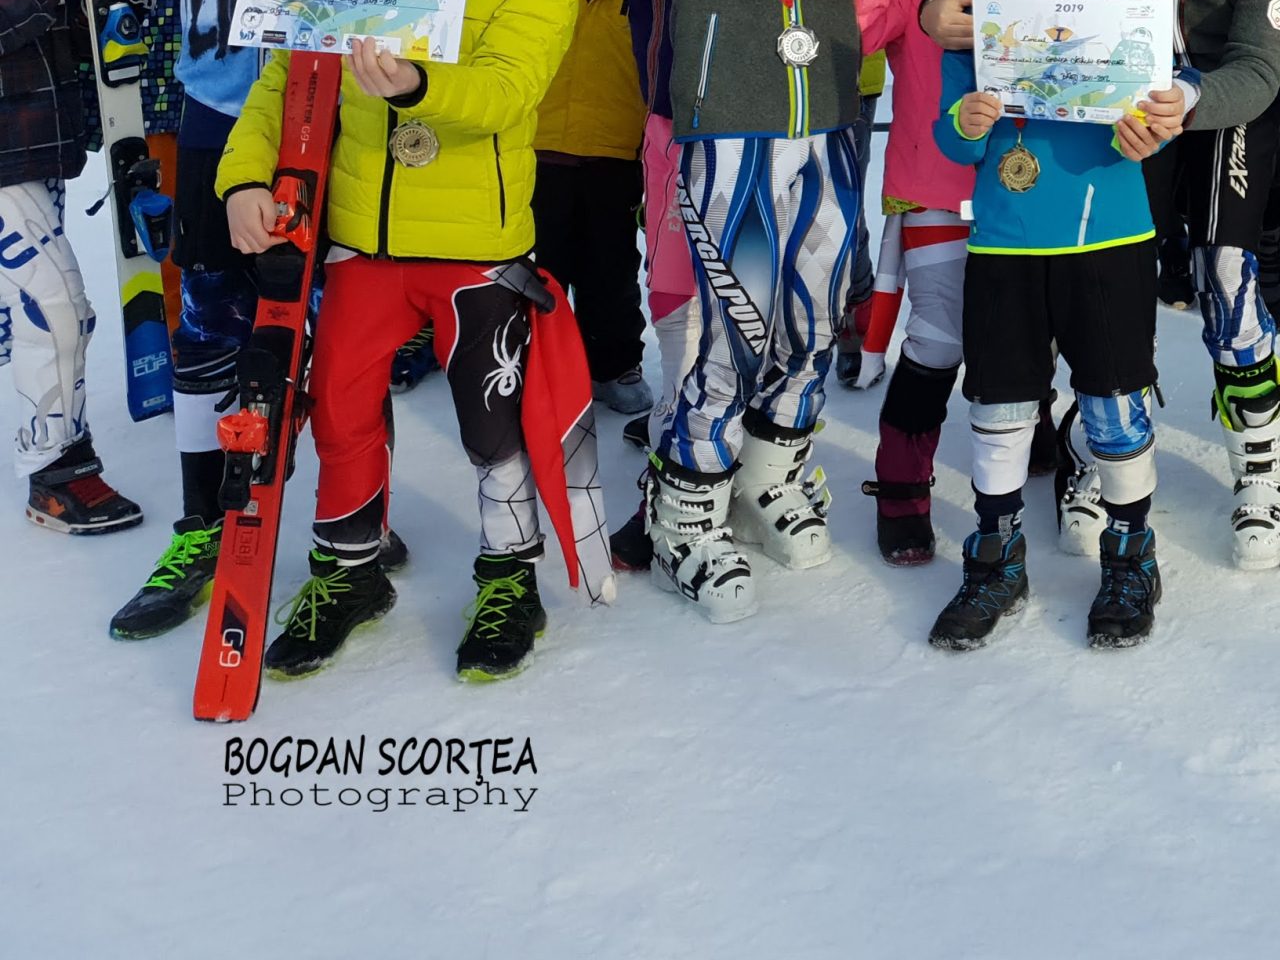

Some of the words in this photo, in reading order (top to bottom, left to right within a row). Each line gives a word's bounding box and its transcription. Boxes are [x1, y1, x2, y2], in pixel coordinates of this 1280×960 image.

[1055, 4, 1084, 13] 2019
[1054, 27, 1064, 41] I
[133, 351, 167, 367] WORLD
[133, 357, 168, 378] CUP
[665, 473, 729, 492] HEAD
[219, 628, 245, 668] G9
